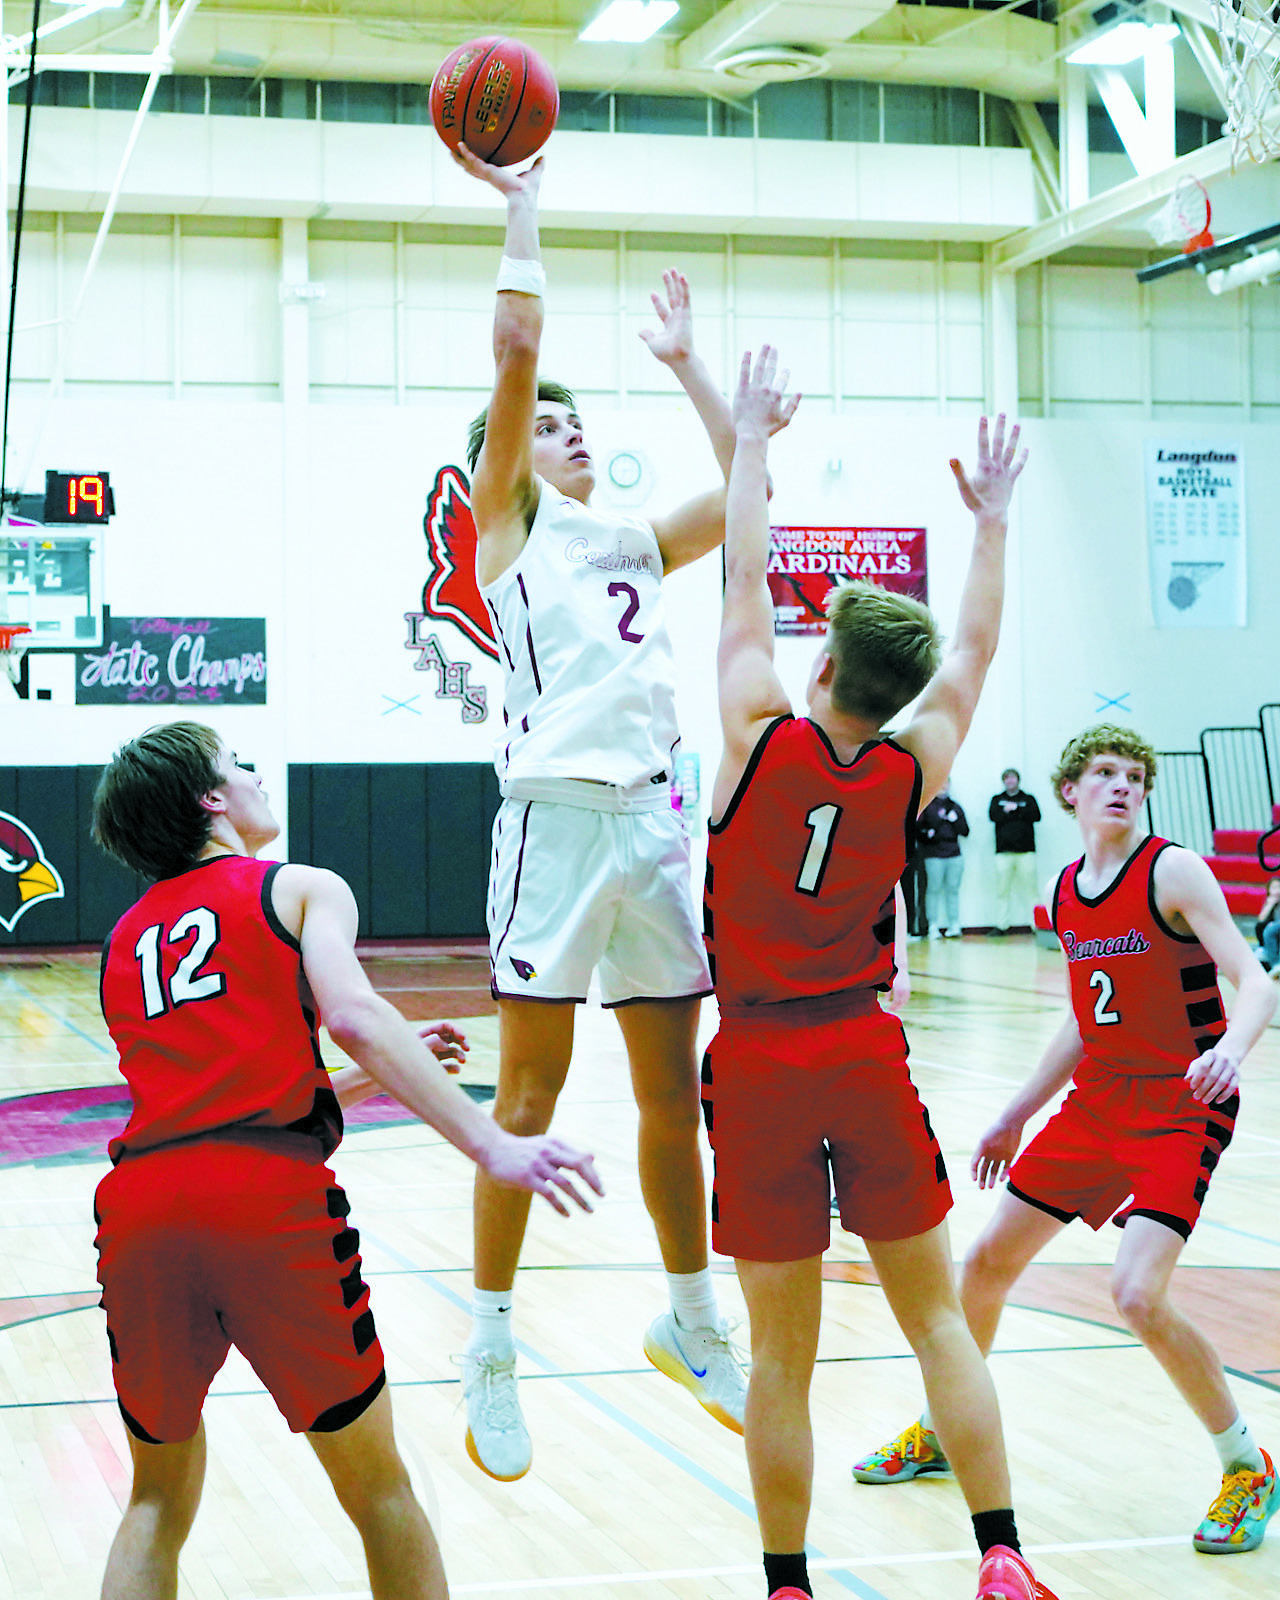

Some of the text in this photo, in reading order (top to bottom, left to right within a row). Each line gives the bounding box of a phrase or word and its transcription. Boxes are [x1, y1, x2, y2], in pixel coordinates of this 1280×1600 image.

[474, 59, 506, 134] LEGACY
[1157, 450, 1238, 466] Langdon
[1177, 467, 1211, 477] BOYS
[68, 475, 105, 517] 19
[1158, 476, 1233, 488] BASKETBALL
[1171, 487, 1217, 498] STATE
[769, 540, 901, 554] ANGDON AREA
[806, 531, 826, 541] TO
[827, 531, 854, 541] THE
[857, 531, 897, 541] HOME
[767, 554, 912, 574] ARDINALS
[607, 581, 645, 644] 2
[80, 634, 266, 694] State Champs
[404, 612, 488, 724] LAHS
[795, 802, 844, 898] 1
[134, 905, 228, 1021] 12
[1063, 928, 1151, 962] Bearcats
[1089, 968, 1122, 1027] 2
